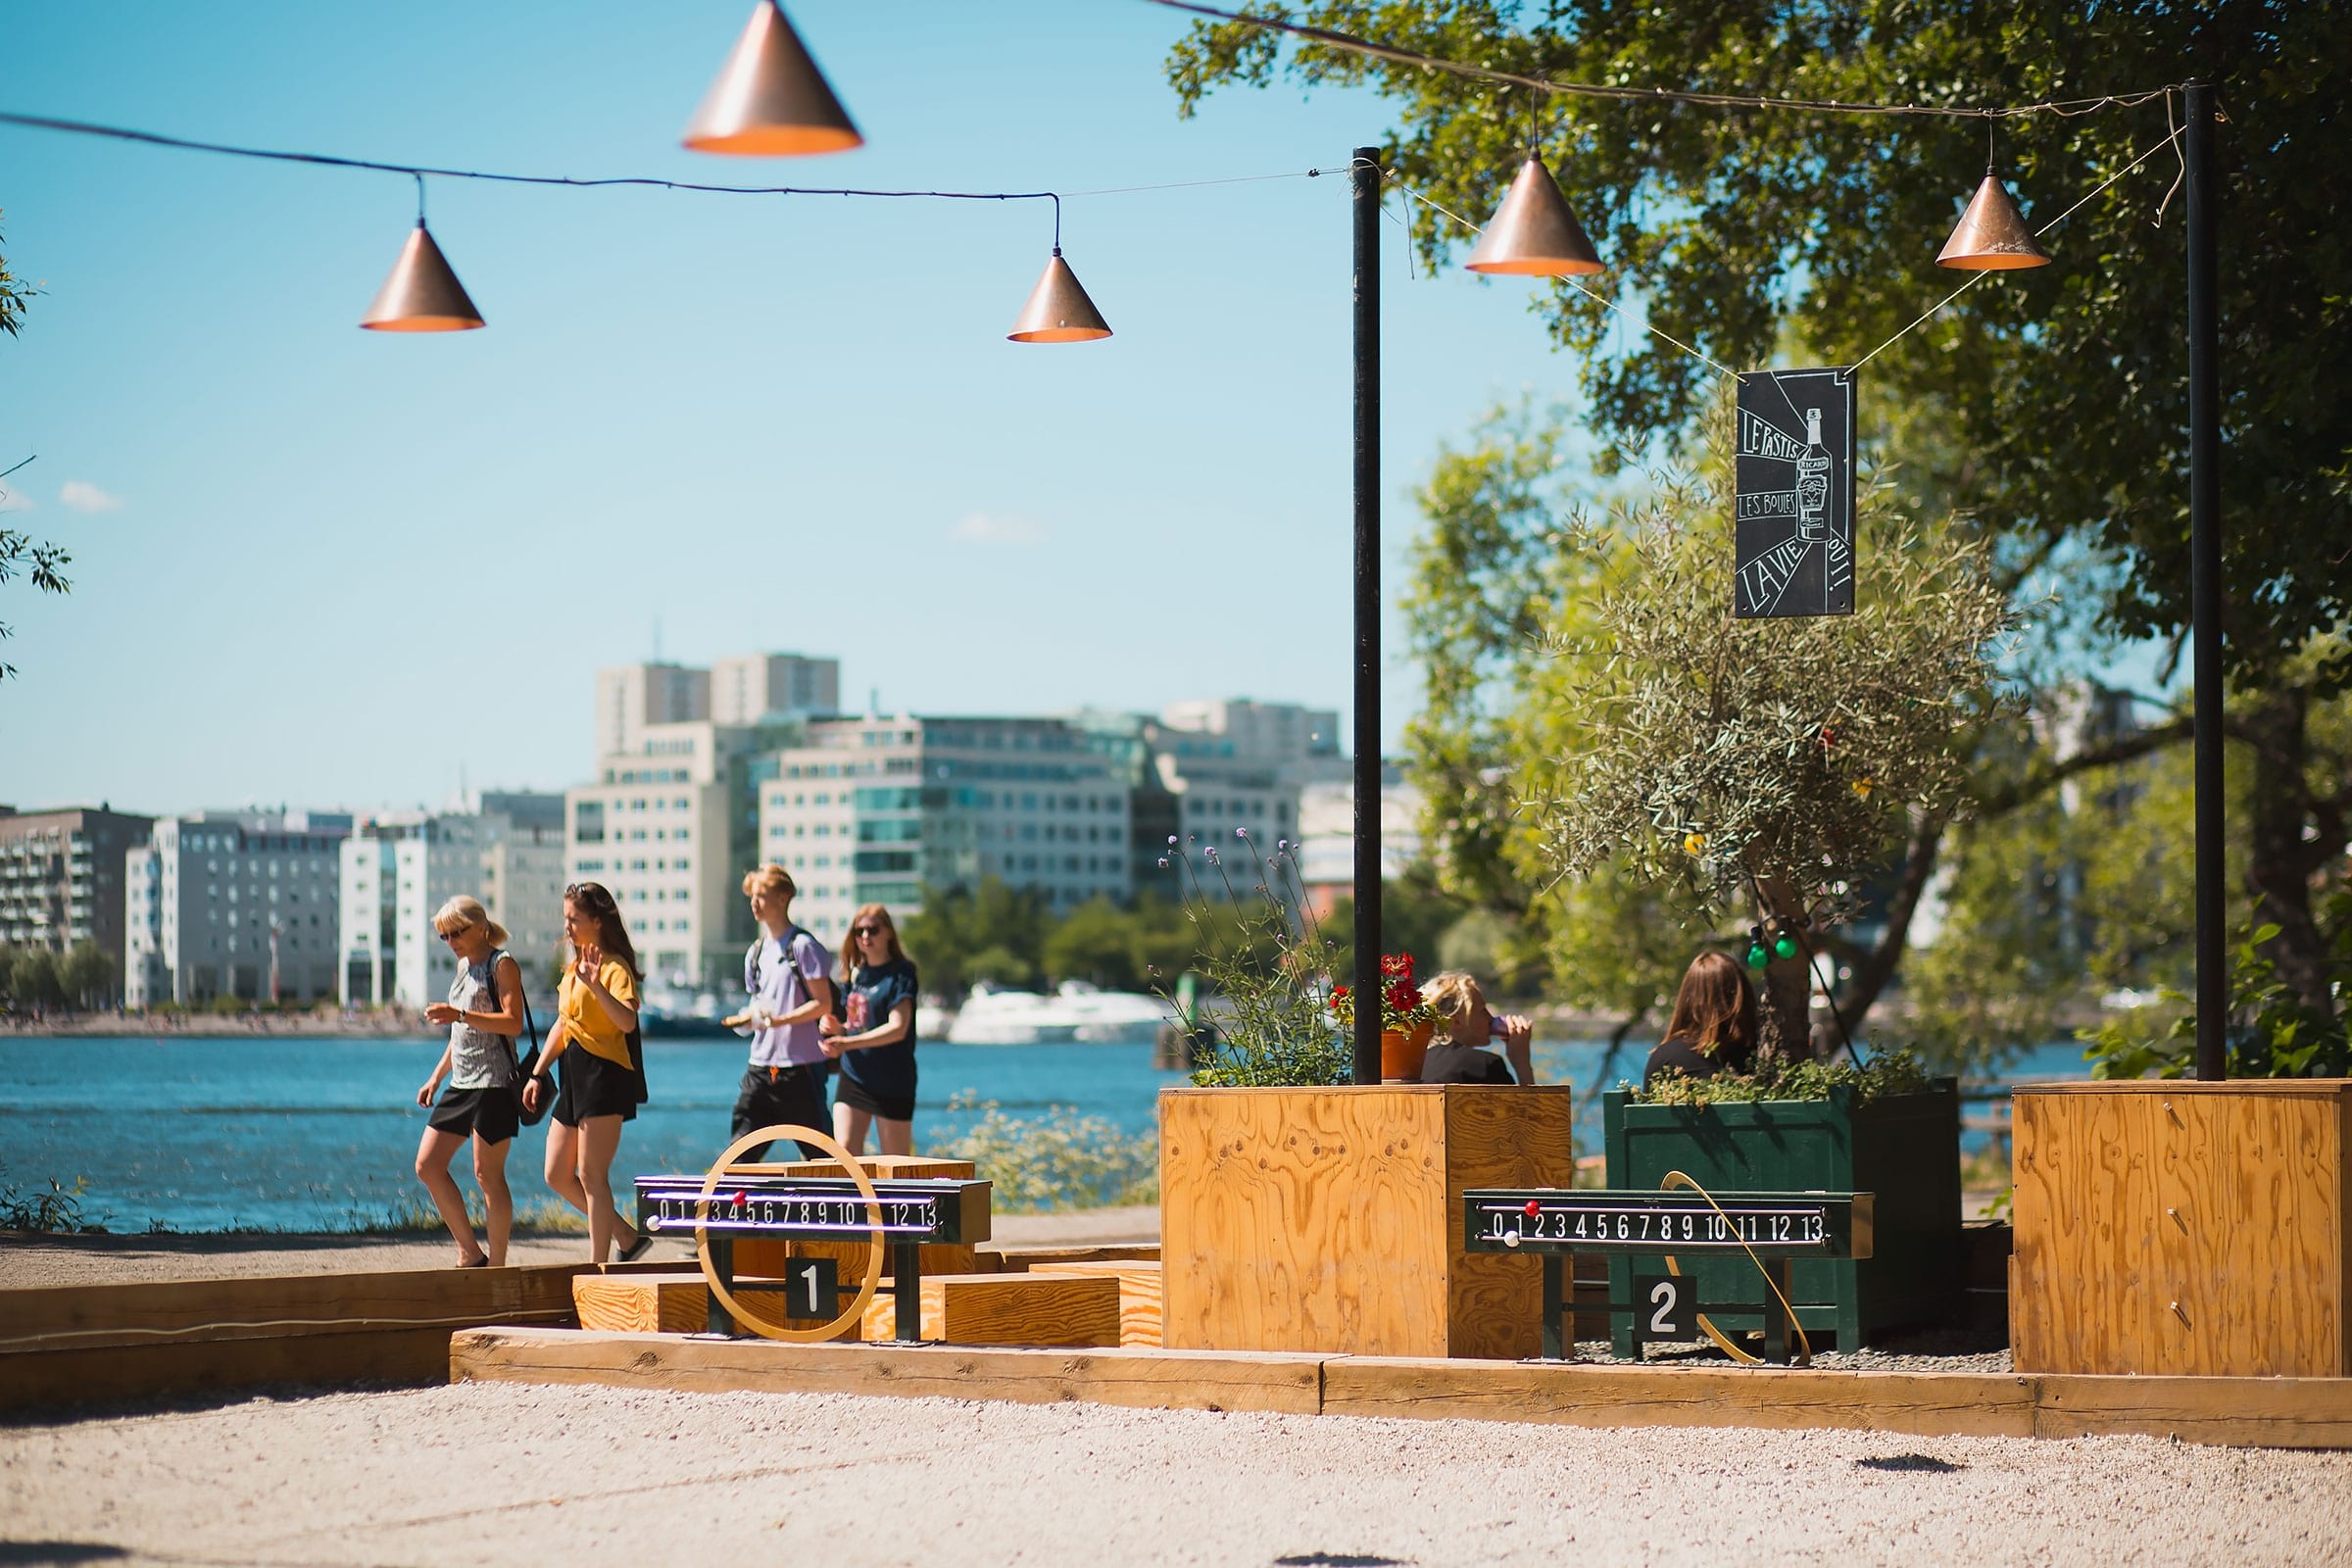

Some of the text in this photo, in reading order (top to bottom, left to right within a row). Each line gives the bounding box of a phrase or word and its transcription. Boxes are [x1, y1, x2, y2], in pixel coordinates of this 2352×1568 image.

[1743, 412, 1799, 459] LE PASTIS
[1739, 493, 1795, 517] LES BOULES
[1741, 539, 1803, 612] LA VIE
[660, 1199, 669, 1220] 0
[678, 1200, 685, 1221] 1
[711, 1200, 720, 1222] 3
[728, 1201, 739, 1222] 4
[746, 1200, 756, 1223] 5
[764, 1201, 773, 1224] 6
[782, 1201, 791, 1224] 7
[800, 1202, 809, 1225] 8
[818, 1201, 827, 1225] 9
[837, 1202, 855, 1225] 10
[891, 1203, 908, 1226] 12
[918, 1203, 936, 1226] 13
[1494, 1212, 1824, 1241] 0 1 2 3 4 5 6 7 8 9 10 11 12 13
[800, 1264, 817, 1313] 1
[1649, 1282, 1677, 1334] 2
